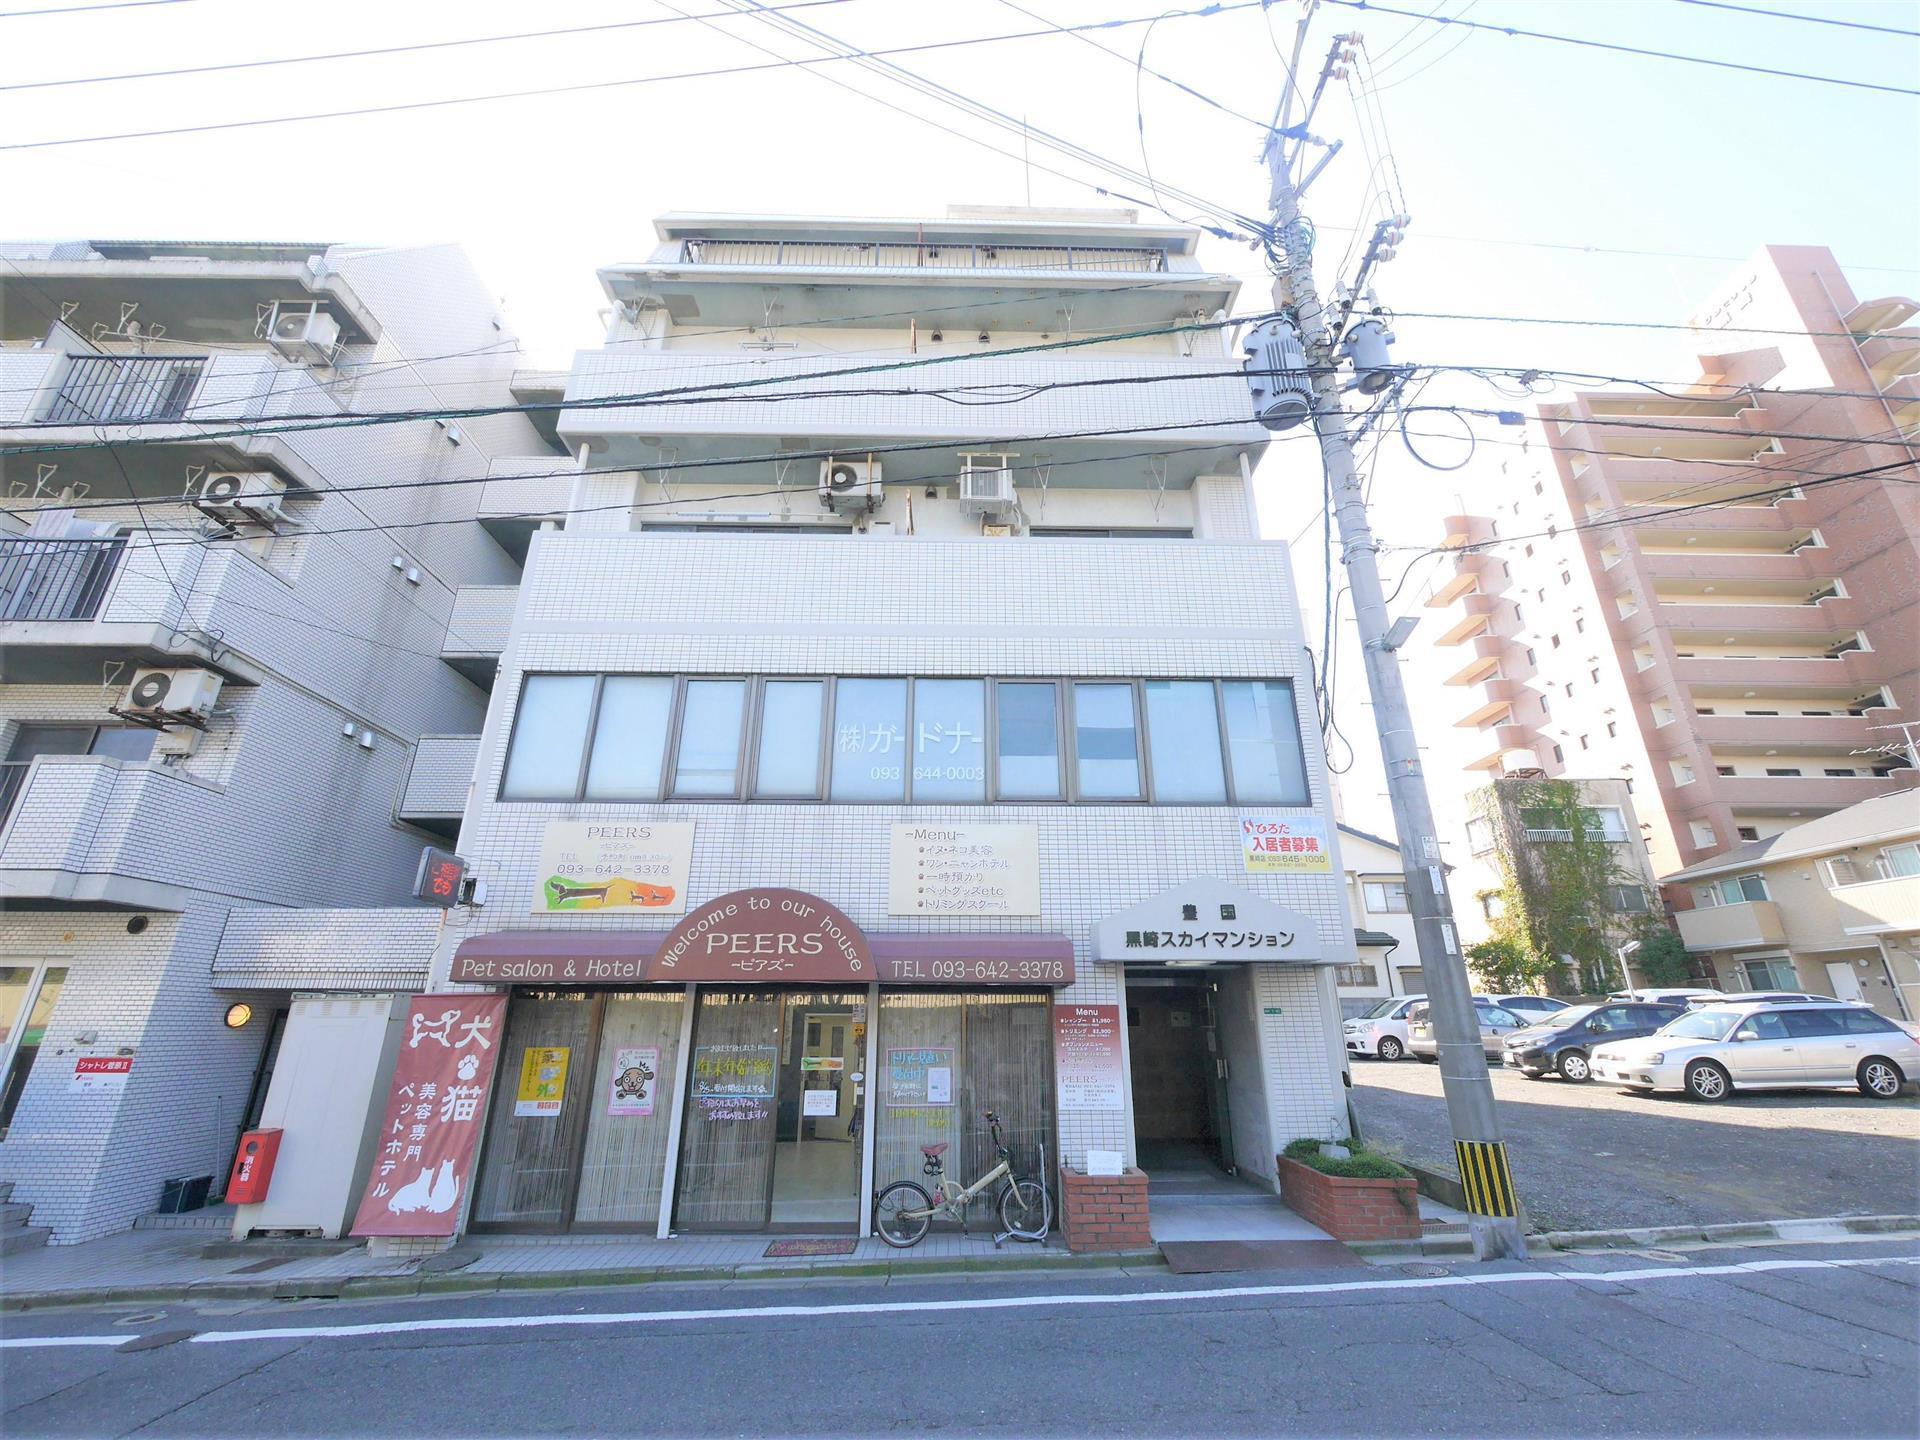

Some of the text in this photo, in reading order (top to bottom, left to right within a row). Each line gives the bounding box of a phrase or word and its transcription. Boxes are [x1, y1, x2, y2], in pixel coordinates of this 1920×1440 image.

[870, 766, 985, 780] 093 644-0003
[587, 826, 652, 839] PEERS
[1255, 822, 1291, 835] ひろた
[1252, 836, 1319, 853] 入居者募集
[557, 863, 671, 875] 093-642-3378
[926, 871, 984, 883] 一時預かり
[924, 898, 1010, 911] トリミングスクール
[661, 896, 863, 972] Welcome to our house
[1125, 930, 1295, 949] 黒崎スカイマンション
[705, 932, 824, 955] PEERS
[461, 959, 642, 977] Pet salon & Hotel
[891, 960, 1064, 979] TEL 093-642-3378
[1075, 1007, 1099, 1016] Menu
[455, 1014, 492, 1049] 犬
[1062, 1076, 1098, 1084] PEERS
[440, 1084, 483, 1123] 猫
[402, 1082, 438, 1162] 美容専門
[372, 1082, 415, 1198] ペットホテル
[240, 1155, 255, 1182] 消火器
